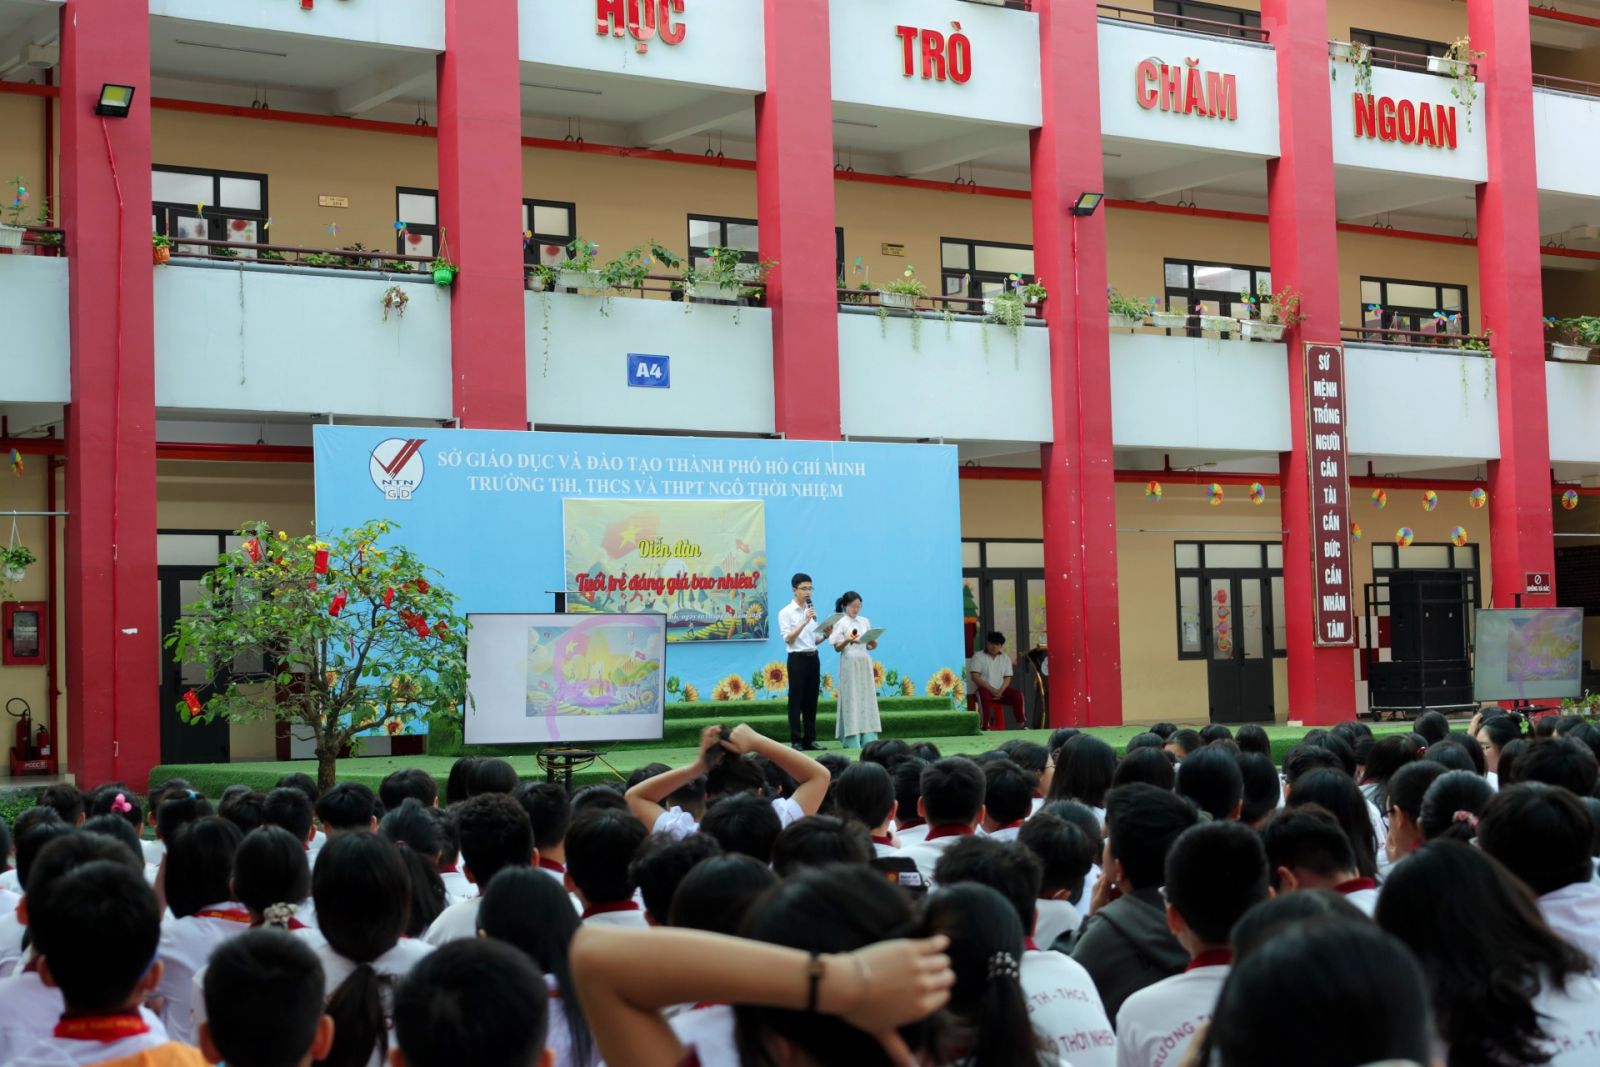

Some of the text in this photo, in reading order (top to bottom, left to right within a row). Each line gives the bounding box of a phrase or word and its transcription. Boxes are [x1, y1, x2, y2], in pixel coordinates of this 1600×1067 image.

[895, 20, 972, 85] TRÒ
[1135, 56, 1238, 121] CHĂM
[1352, 91, 1458, 150] NGOAN
[636, 362, 663, 379] A4
[1318, 352, 1331, 371] SỨ
[1313, 378, 1338, 401] MỆNH
[1315, 431, 1341, 451] NGƯỜI
[438, 448, 866, 476] SỞ GIÁO DỤC VÀ ĐÀO TẠO THÀNH PHỐ HỒ CHÍ MINH
[467, 472, 545, 493] TRƯỜNG
[586, 478, 631, 494] THCS
[634, 475, 658, 495] VÀ
[662, 479, 705, 496] THPT
[709, 477, 744, 496] NGÔ
[747, 478, 788, 497] THỜI
[791, 481, 844, 501] NHIỆM
[1323, 484, 1338, 504] TÀI
[639, 536, 703, 558] Diễn đàn
[1324, 538, 1341, 558] ĐỨC
[576, 570, 761, 596] Tuổi trẻ đáng giá bao nhiêu?
[1323, 592, 1346, 612] NHÂN
[1326, 619, 1345, 638] TÂM
